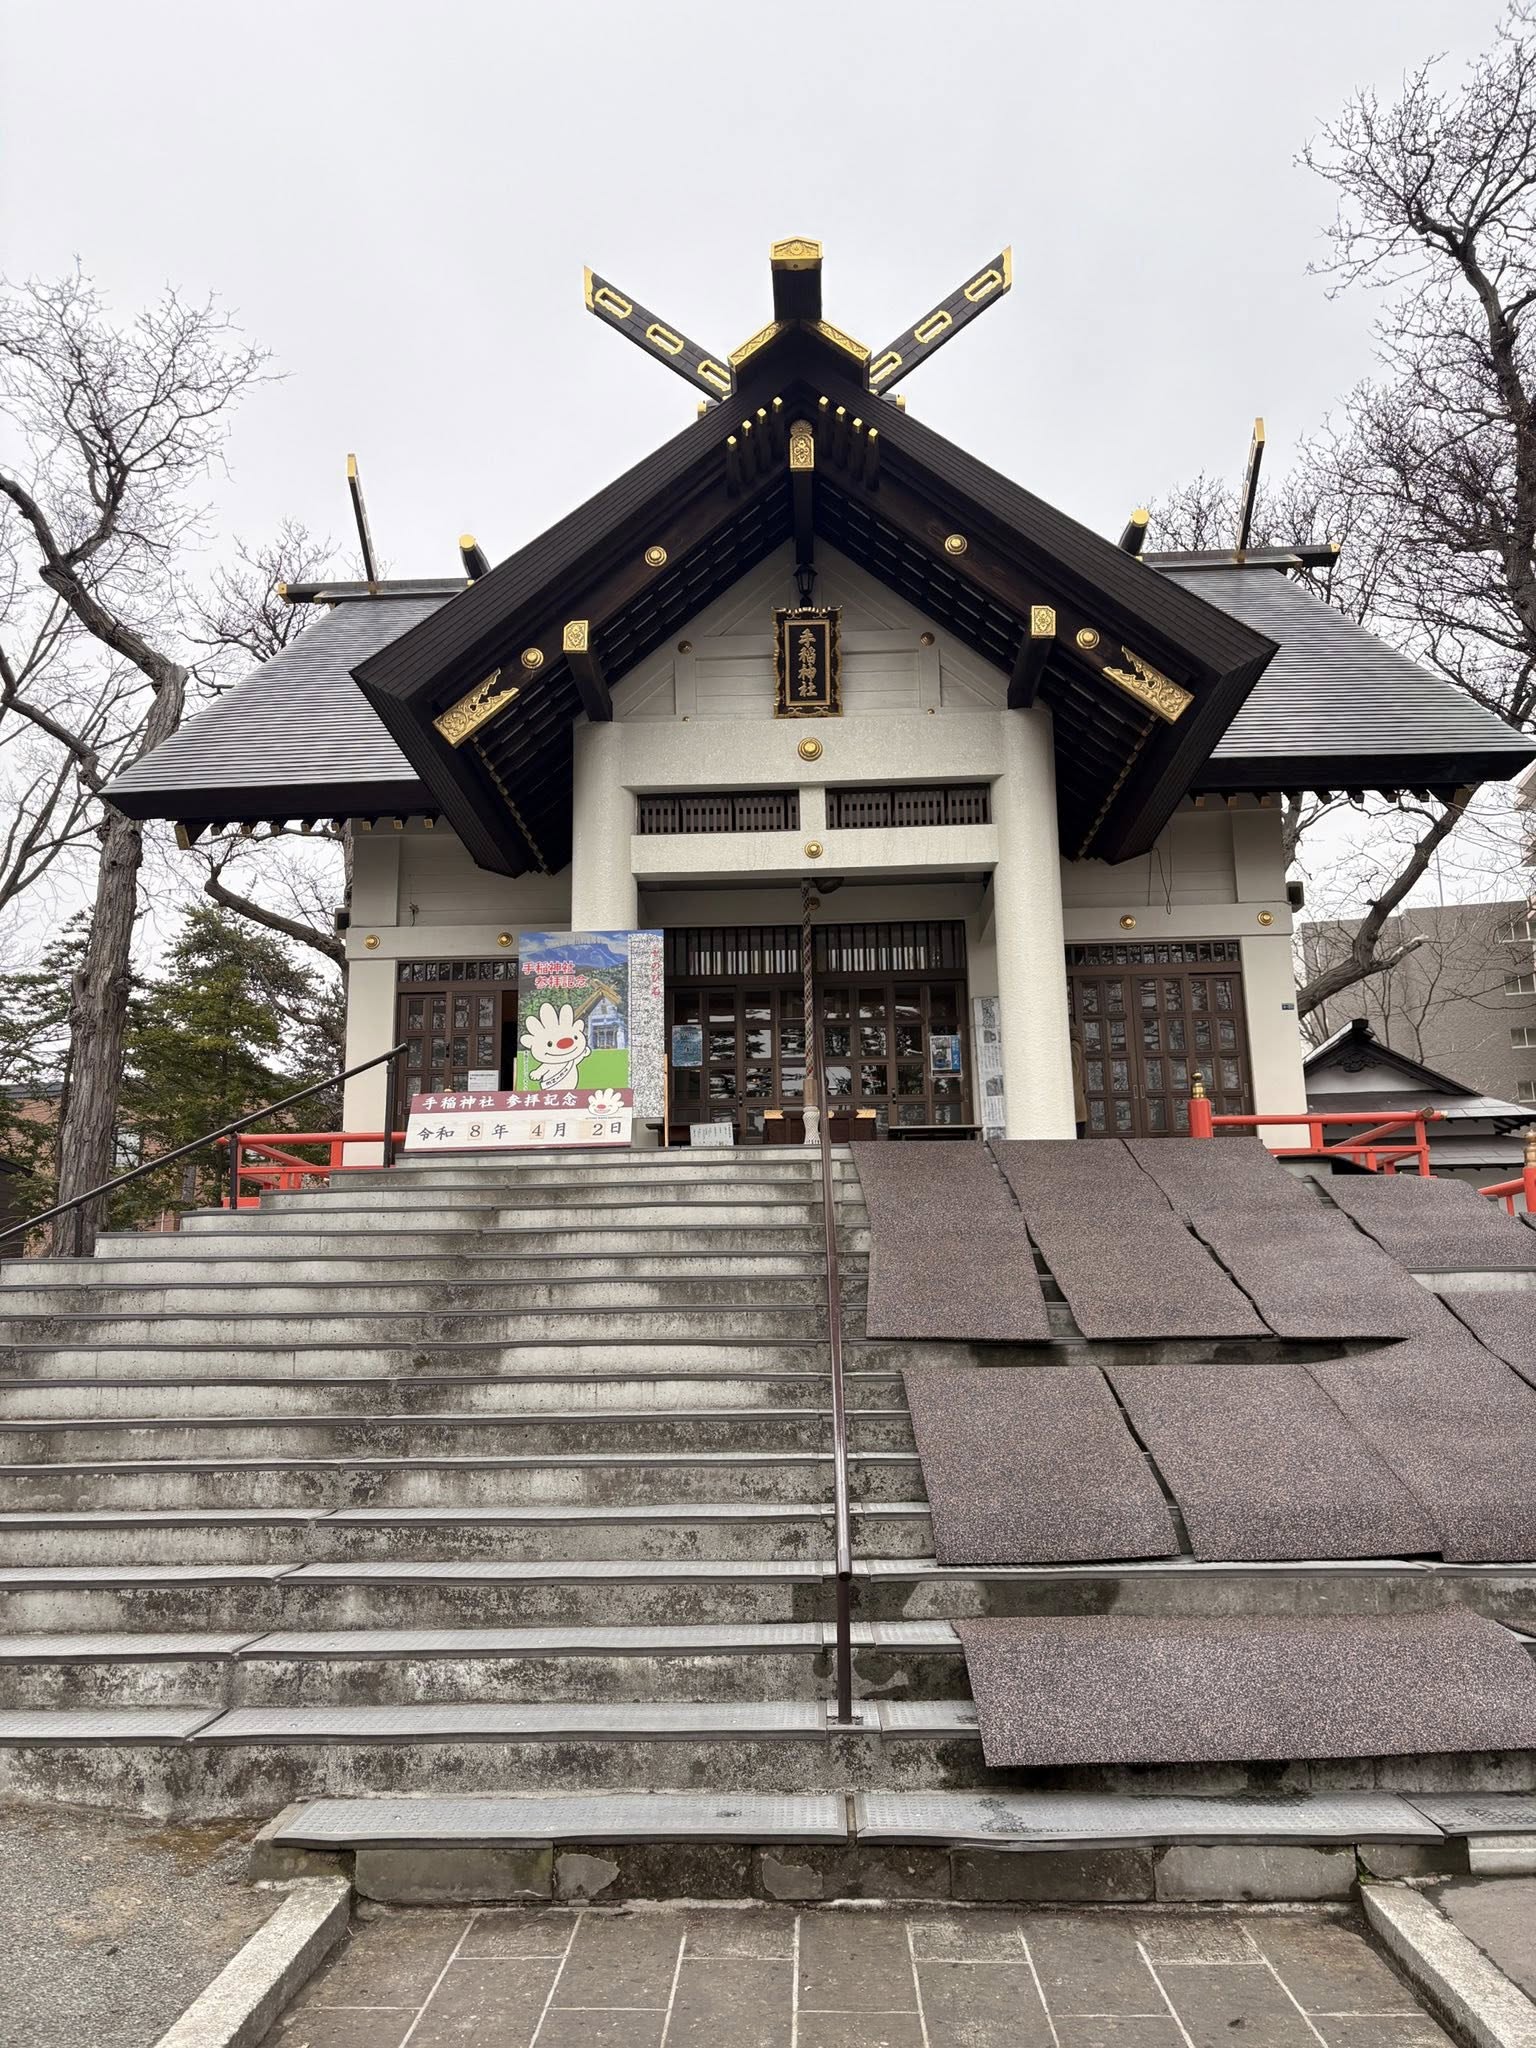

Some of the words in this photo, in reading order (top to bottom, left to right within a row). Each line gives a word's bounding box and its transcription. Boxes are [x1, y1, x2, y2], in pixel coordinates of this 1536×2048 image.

[798, 628, 818, 697] 手稲神社
[522, 960, 576, 975] 手稲神社
[534, 974, 588, 989] 参拝記念
[421, 1095, 495, 1111] 手稲神社
[506, 1092, 578, 1108] 参拝記念
[416, 1126, 455, 1141] 令和
[469, 1124, 481, 1138] 8
[491, 1123, 509, 1139] 年
[531, 1124, 542, 1137] 4
[553, 1121, 567, 1138] 月
[592, 1123, 603, 1136] 2
[610, 1121, 622, 1135] 日
